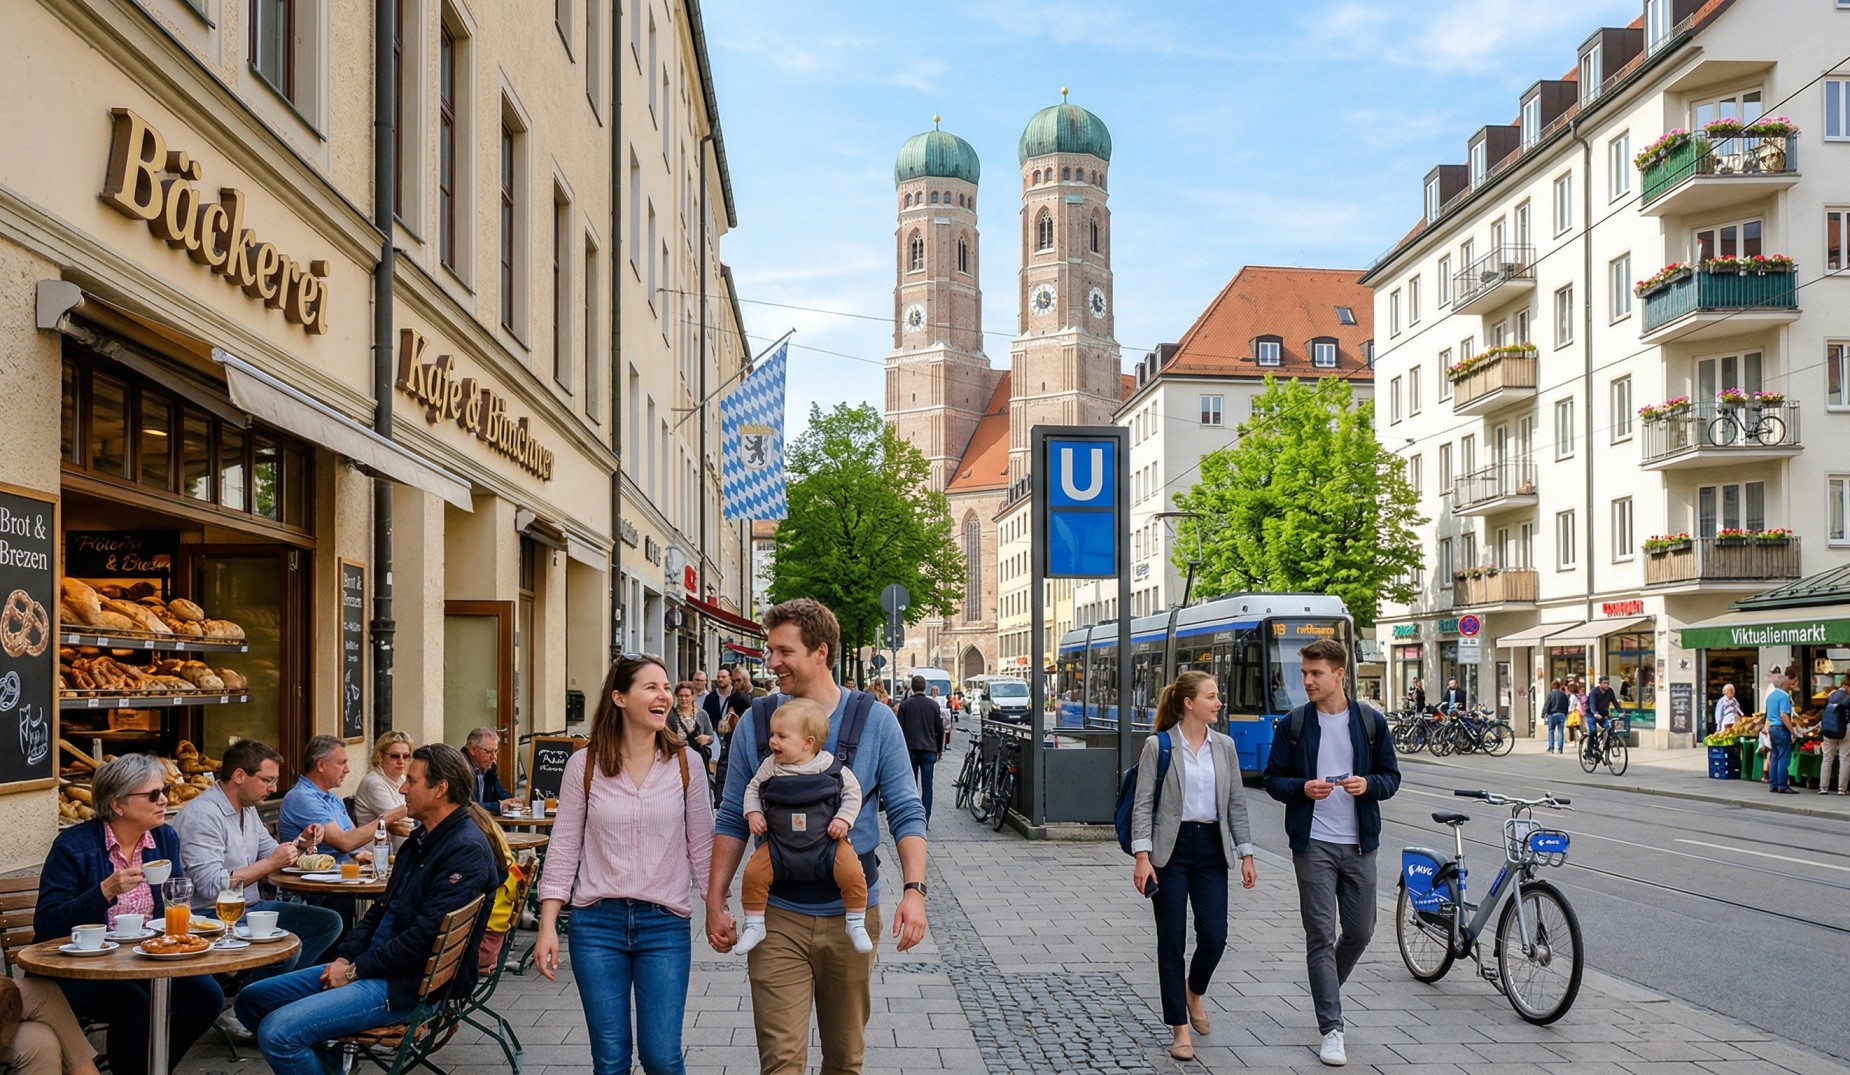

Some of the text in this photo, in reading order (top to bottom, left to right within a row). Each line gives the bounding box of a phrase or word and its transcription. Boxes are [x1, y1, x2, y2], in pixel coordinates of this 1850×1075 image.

[100, 107, 330, 335] Bäckerei
[397, 328, 463, 424] Kafe
[460, 378, 483, 433] &
[1061, 447, 1103, 501] U
[0, 507, 47, 540] Brot &
[0, 539, 48, 570] Brezen
[1731, 624, 1827, 645] Viktualienmarkt
